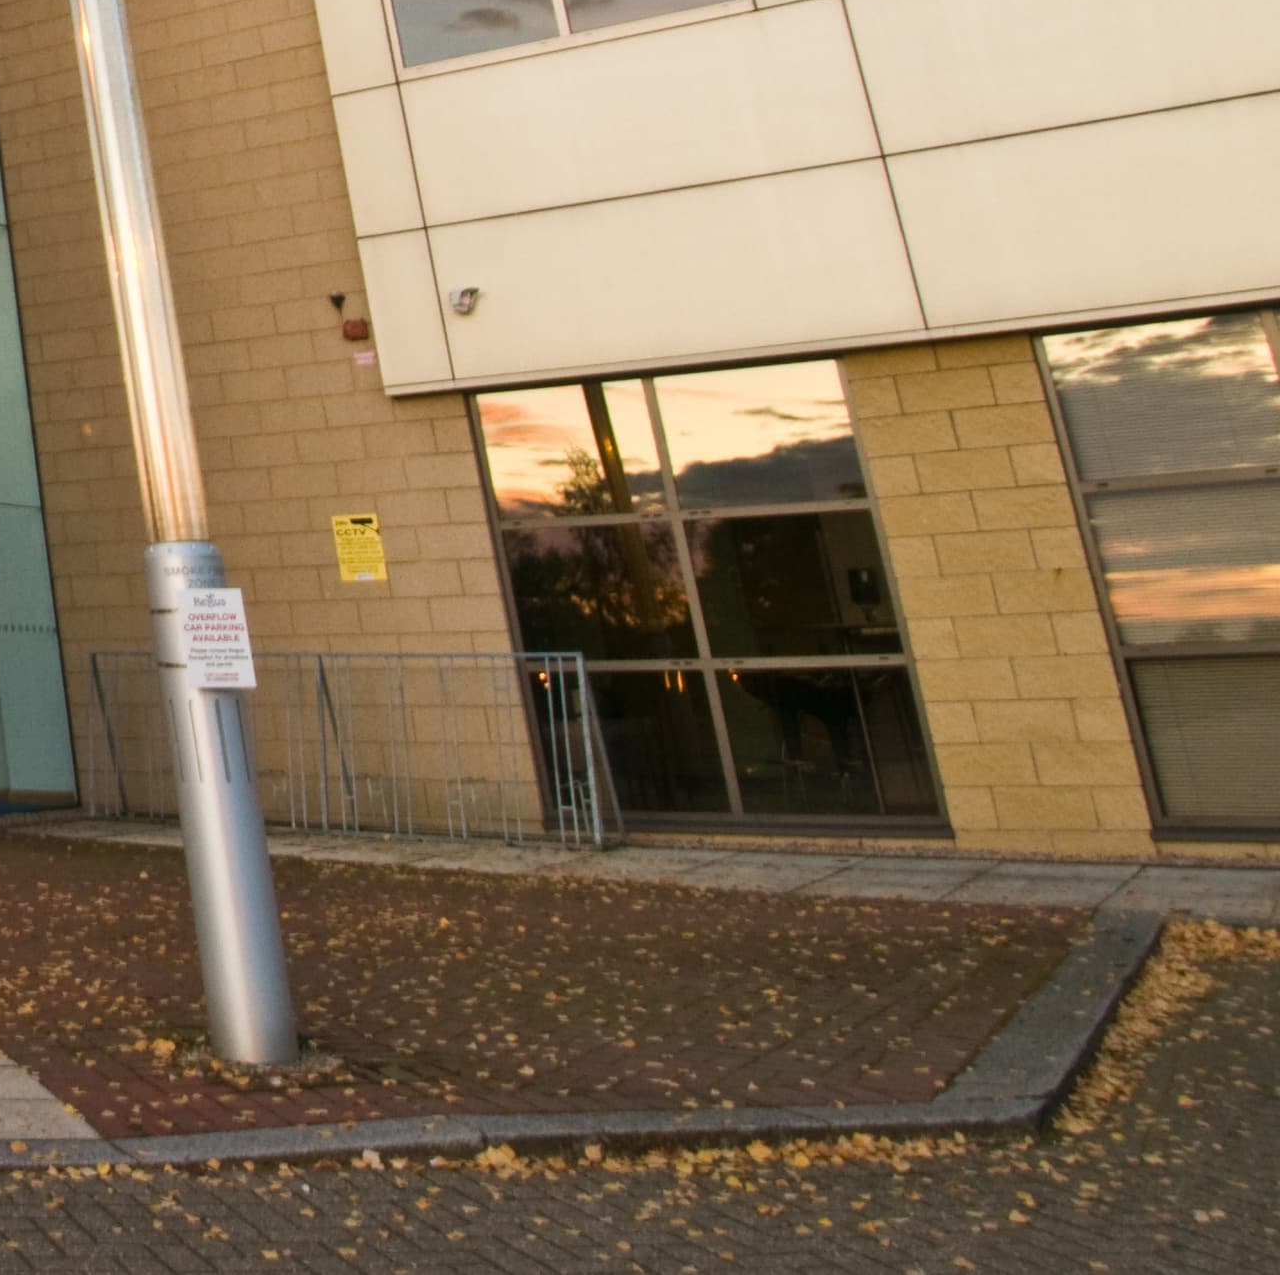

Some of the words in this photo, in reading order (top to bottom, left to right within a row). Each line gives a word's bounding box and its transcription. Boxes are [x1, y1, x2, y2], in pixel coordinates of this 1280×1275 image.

[336, 528, 366, 536] CCTV
[188, 613, 237, 621] OVERFLOW
[184, 624, 202, 632] CAR
[205, 624, 244, 632] PARKING
[192, 634, 240, 642] AVAILABLE
